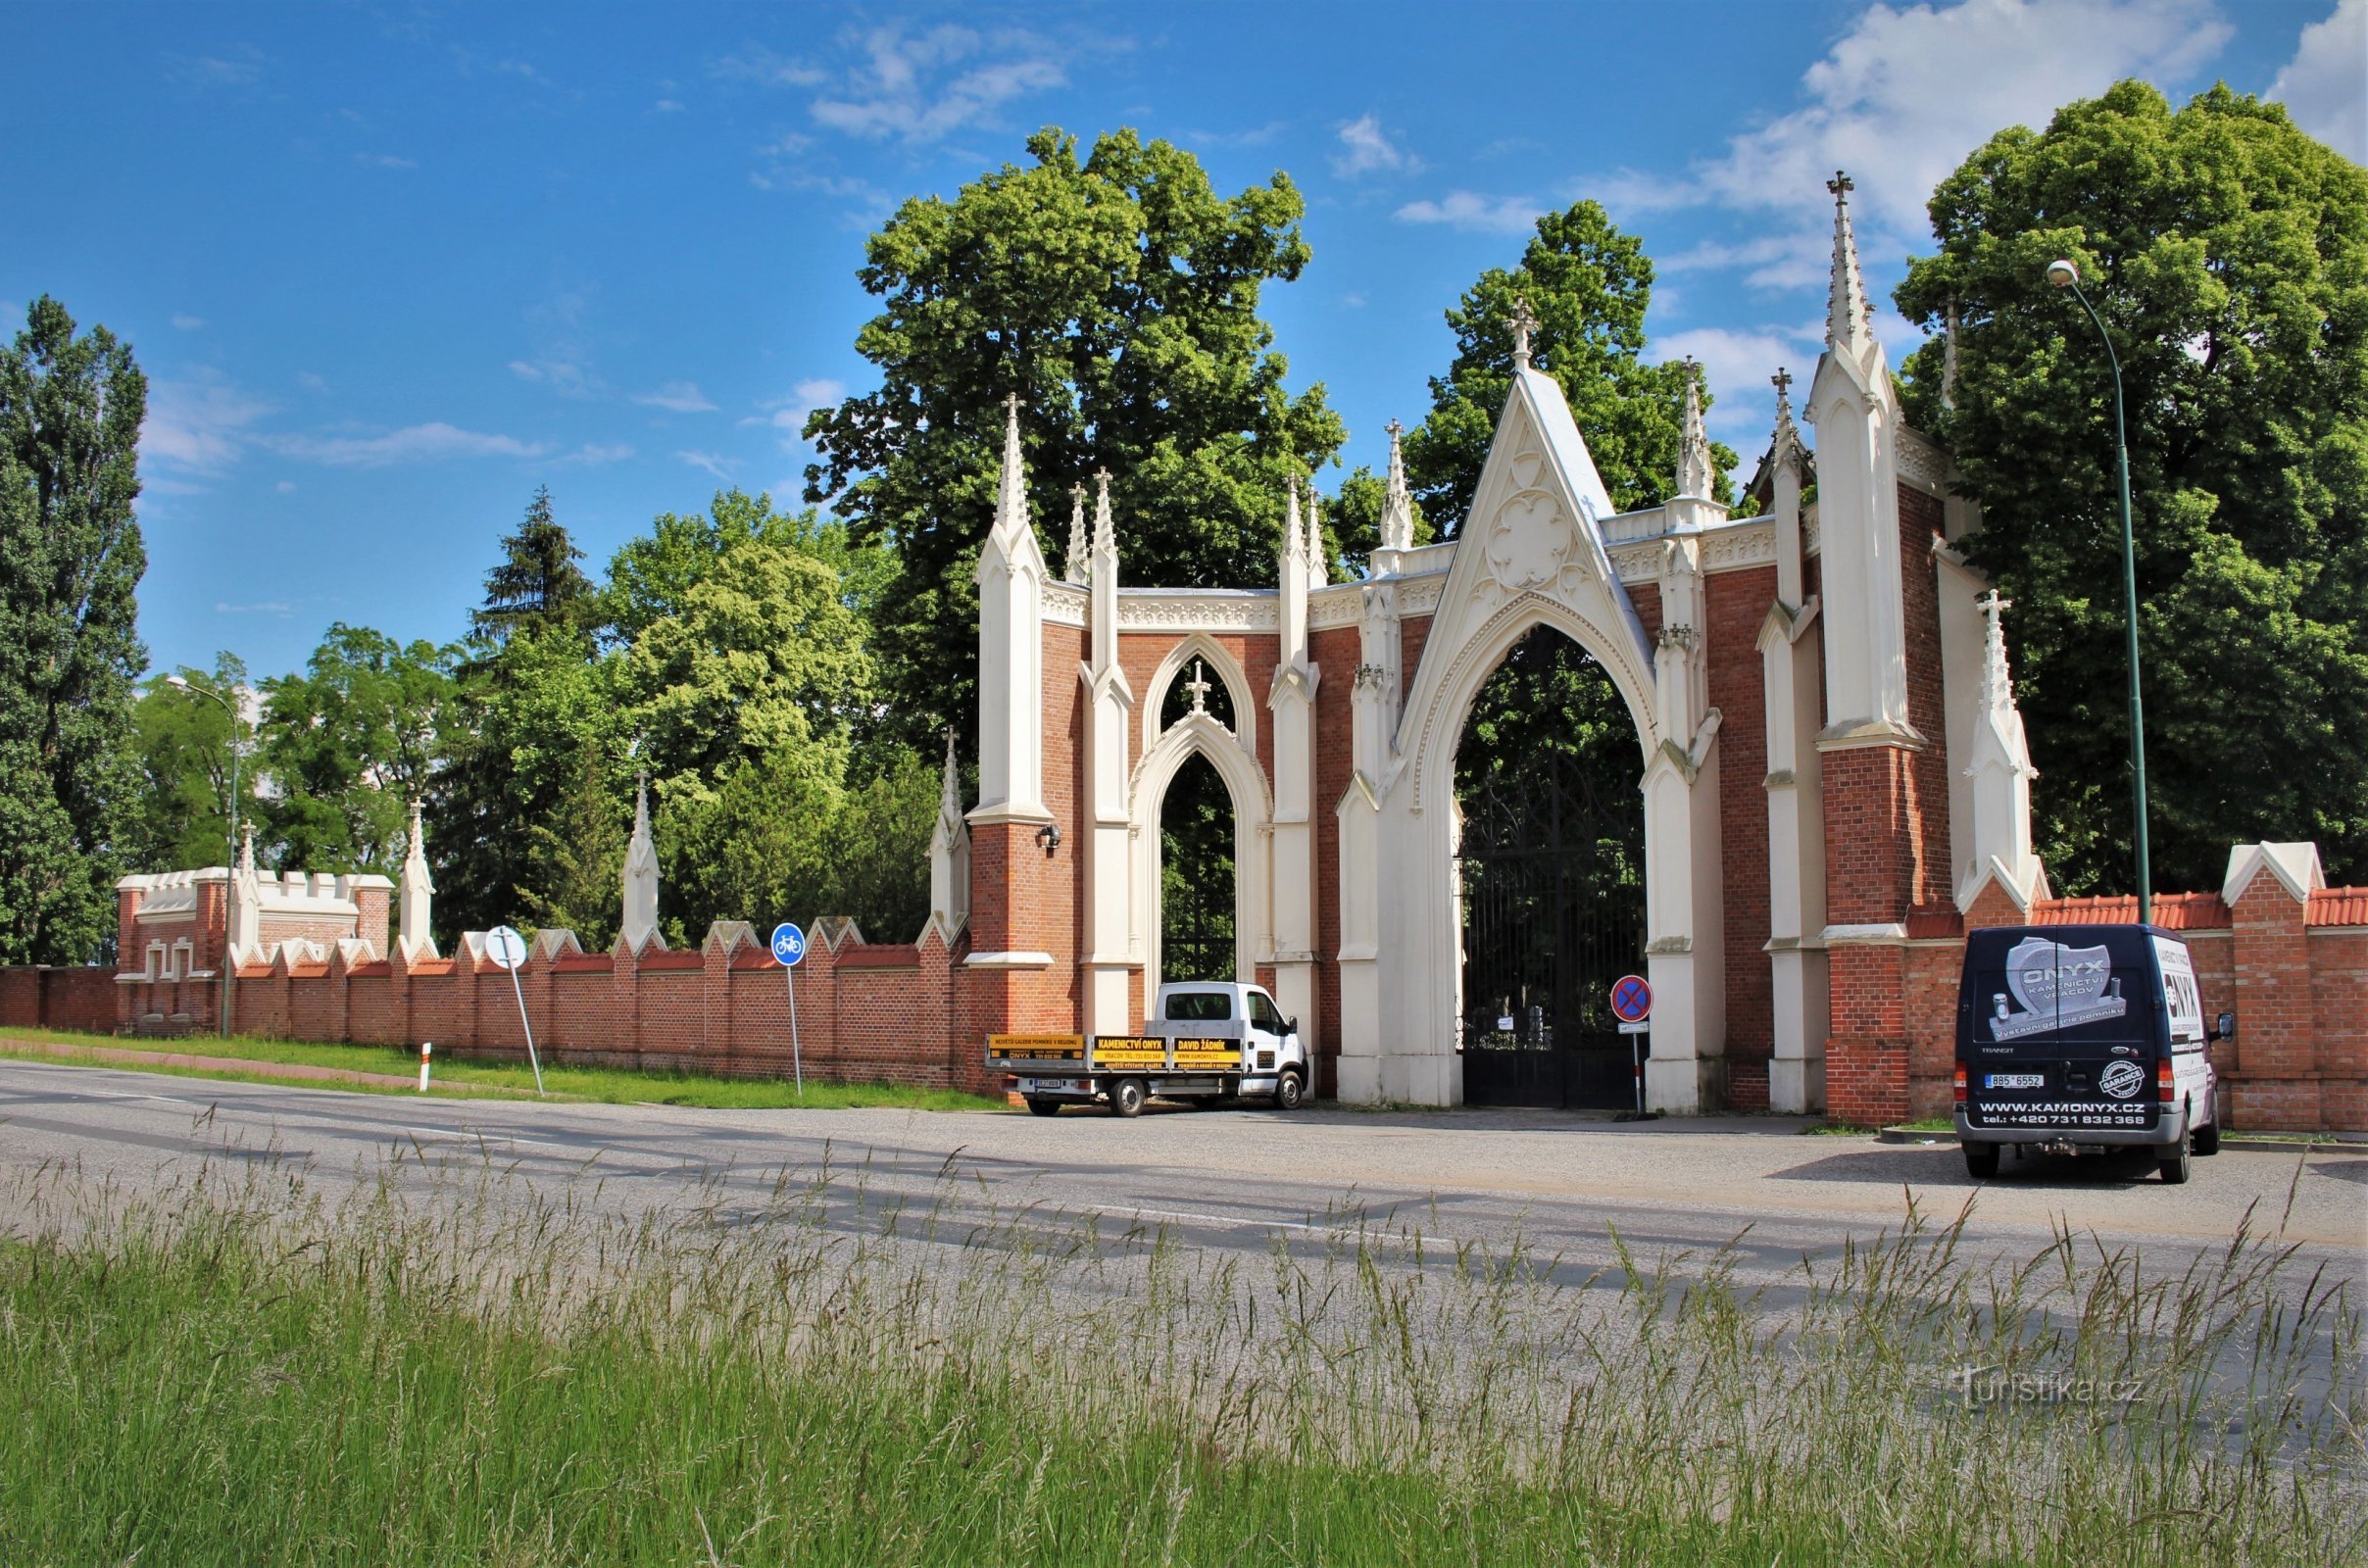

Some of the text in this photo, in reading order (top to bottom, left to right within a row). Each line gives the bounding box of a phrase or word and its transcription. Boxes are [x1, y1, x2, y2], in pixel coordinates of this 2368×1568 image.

[2023, 960, 2104, 984] ONYX
[1099, 1038, 1162, 1050] KAMENICTVÍ ONYX
[1178, 1039, 1225, 1051] DAVID ŽÁDNÍK
[2016, 1076, 2040, 1086] 6552
[2102, 1069, 2142, 1089] GARANCE
[1980, 1102, 2146, 1113] WWW.KAMONYX.CZ
[2049, 1115, 2078, 1124] 731
[2083, 1115, 2112, 1124] 832
[2114, 1115, 2145, 1124] 368
